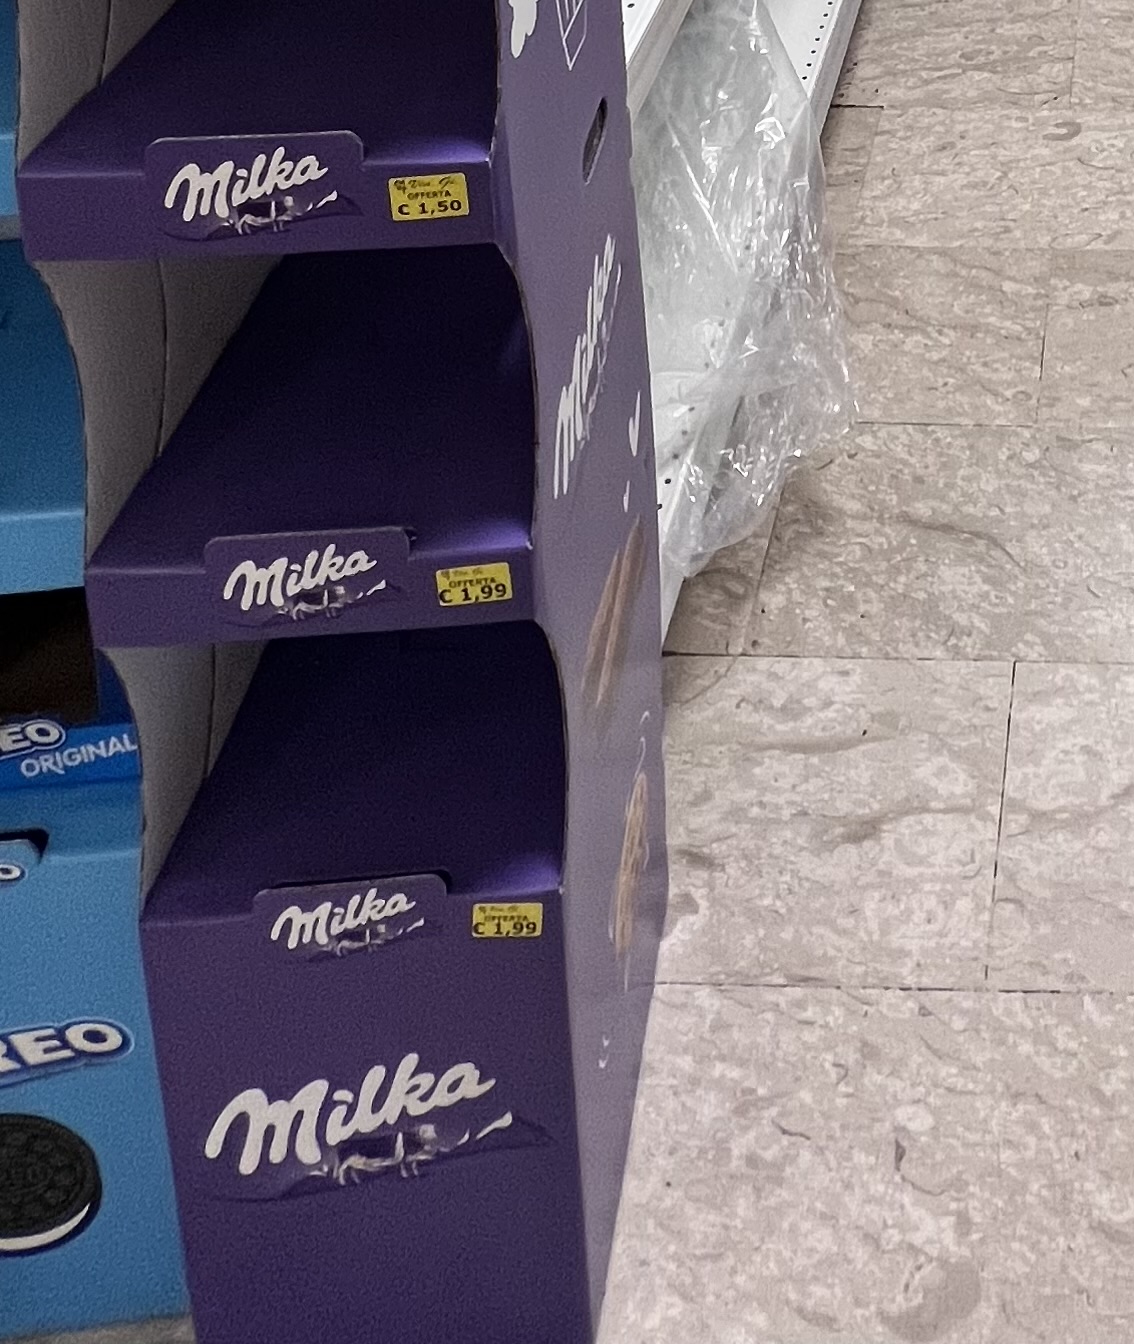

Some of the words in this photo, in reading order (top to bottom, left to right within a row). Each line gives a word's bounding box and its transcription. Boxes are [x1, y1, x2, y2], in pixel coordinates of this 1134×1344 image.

[164, 146, 329, 222] Milka
[406, 189, 452, 201] OFFERTA
[418, 199, 462, 216] 1,50
[552, 234, 616, 500] Milka
[222, 543, 378, 611] Milka
[460, 582, 507, 603] 1,99
[20, 733, 138, 778] ORIGINAL
[270, 887, 417, 950] Milka
[494, 921, 537, 937] 1,99
[204, 1052, 497, 1176] Milka
